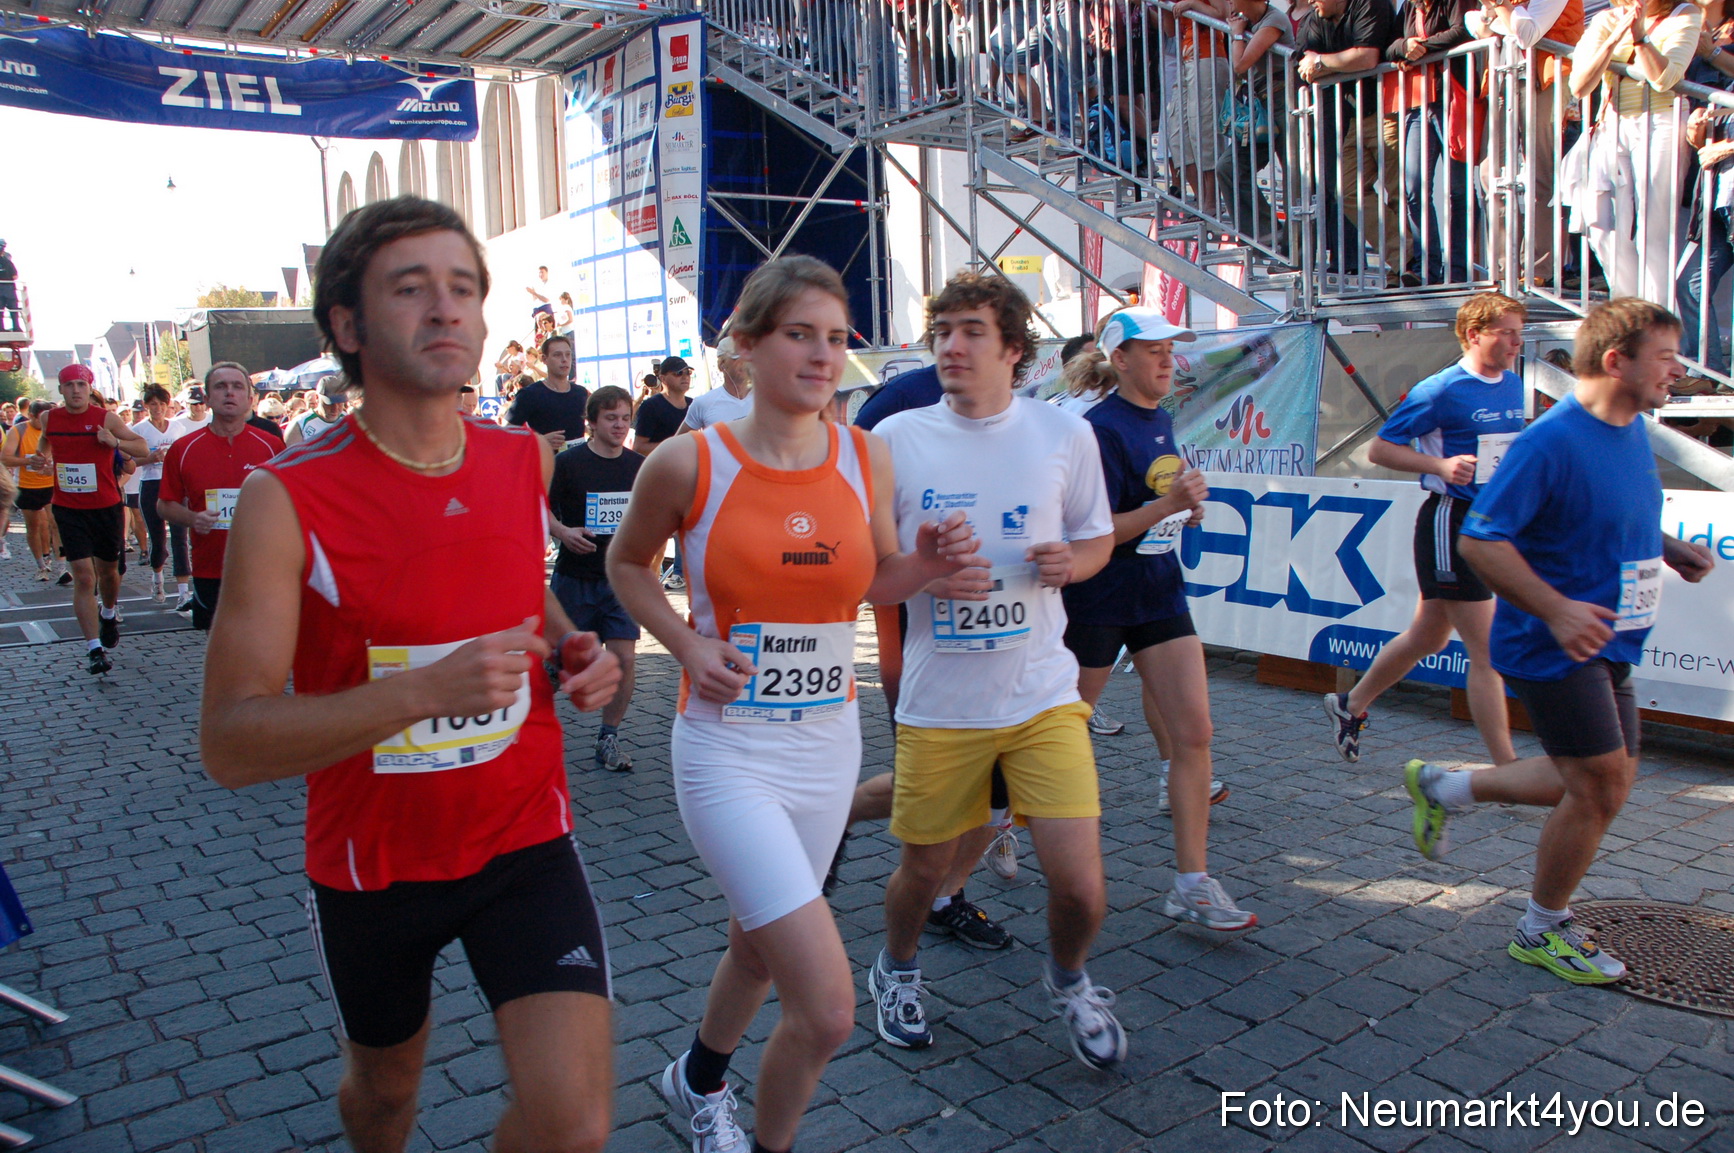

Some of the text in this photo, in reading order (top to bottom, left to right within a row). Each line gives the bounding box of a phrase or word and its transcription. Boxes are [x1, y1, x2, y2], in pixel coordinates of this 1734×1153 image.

[158, 66, 302, 116] ZIEL
[389, 119, 467, 127] www.mizunoeurope.com
[1022, 349, 1062, 387] Leben
[1181, 443, 1305, 476] NEUMARKTER
[67, 476, 87, 485] 945
[599, 496, 629, 505] Christian
[922, 488, 939, 510] 6.
[782, 551, 830, 565] PUMA
[936, 601, 947, 615] C
[957, 601, 1026, 630] 2400
[762, 635, 817, 653] Katrin
[761, 665, 843, 696] 2398
